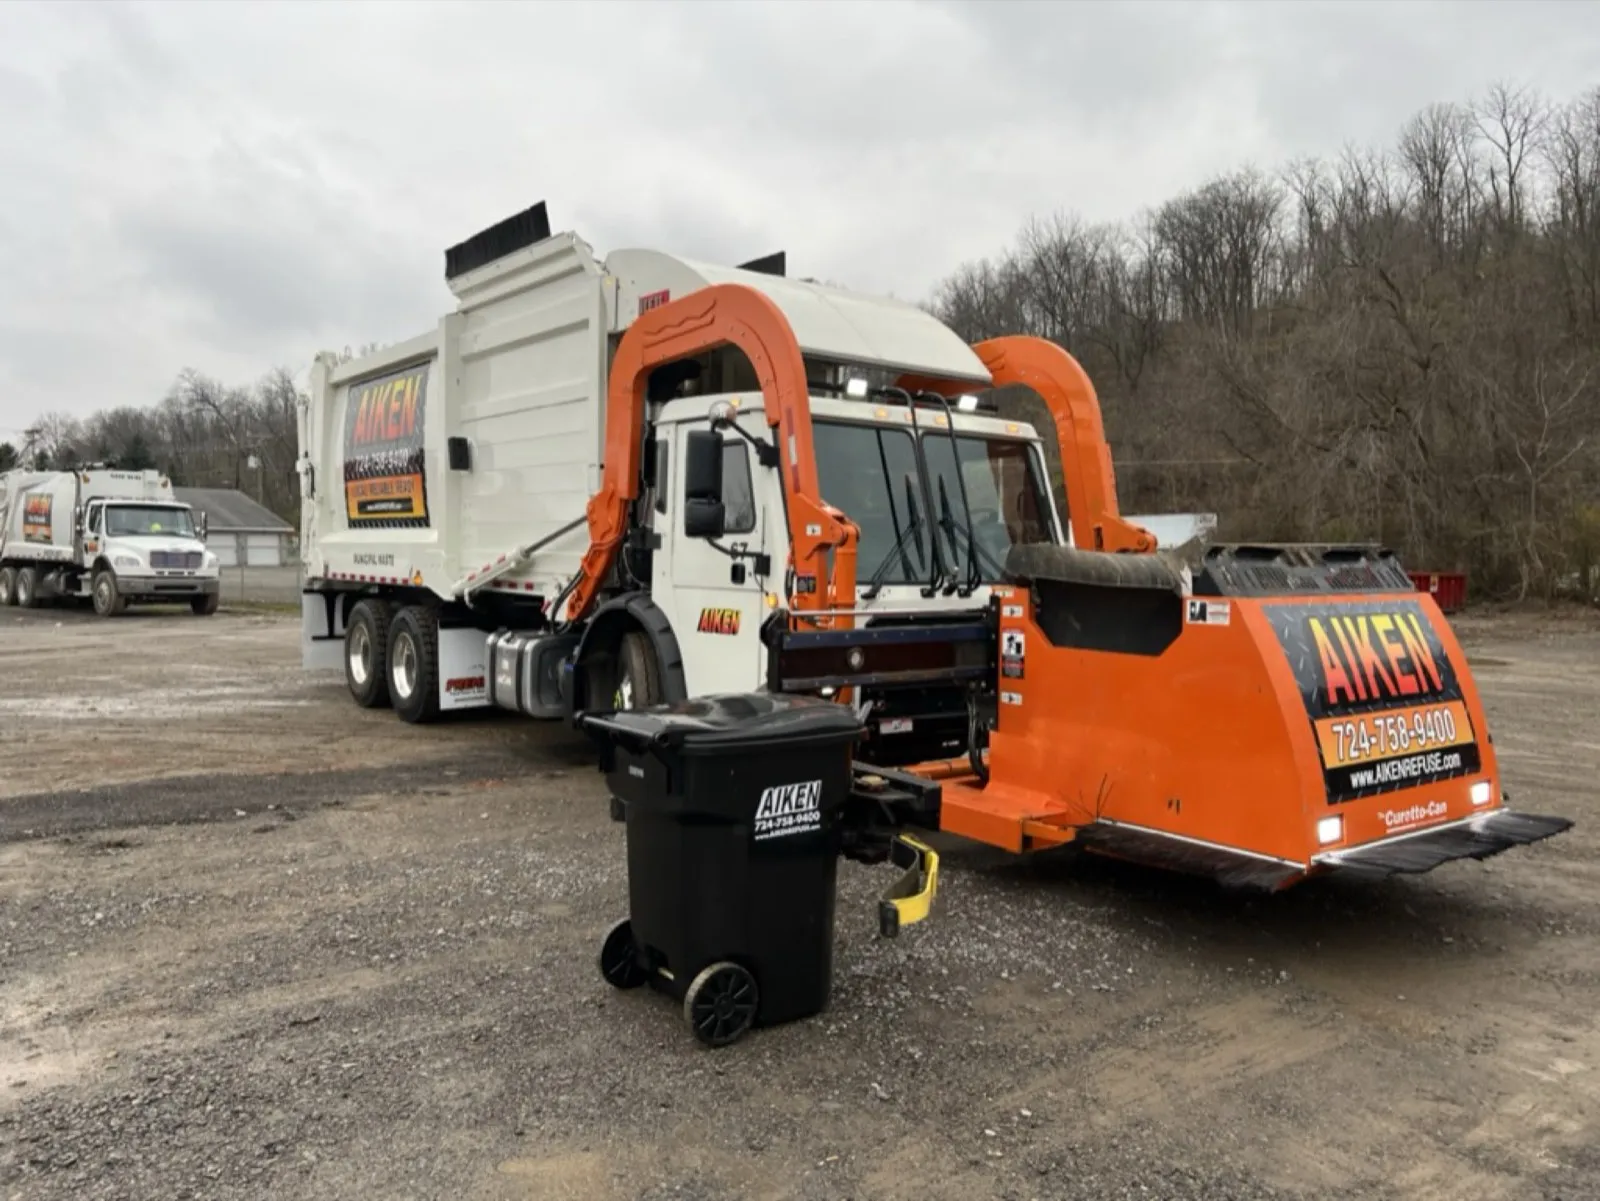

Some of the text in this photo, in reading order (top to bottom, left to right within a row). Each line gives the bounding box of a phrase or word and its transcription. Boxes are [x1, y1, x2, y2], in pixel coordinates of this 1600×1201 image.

[353, 373, 424, 443] AIKEN
[697, 607, 742, 635] AIKEN
[1309, 612, 1443, 705] AIKEN
[1332, 708, 1456, 761] 724-758-9400
[1350, 752, 1462, 789] www.AIKENREFUSE.com
[755, 779, 822, 819] AIKEN
